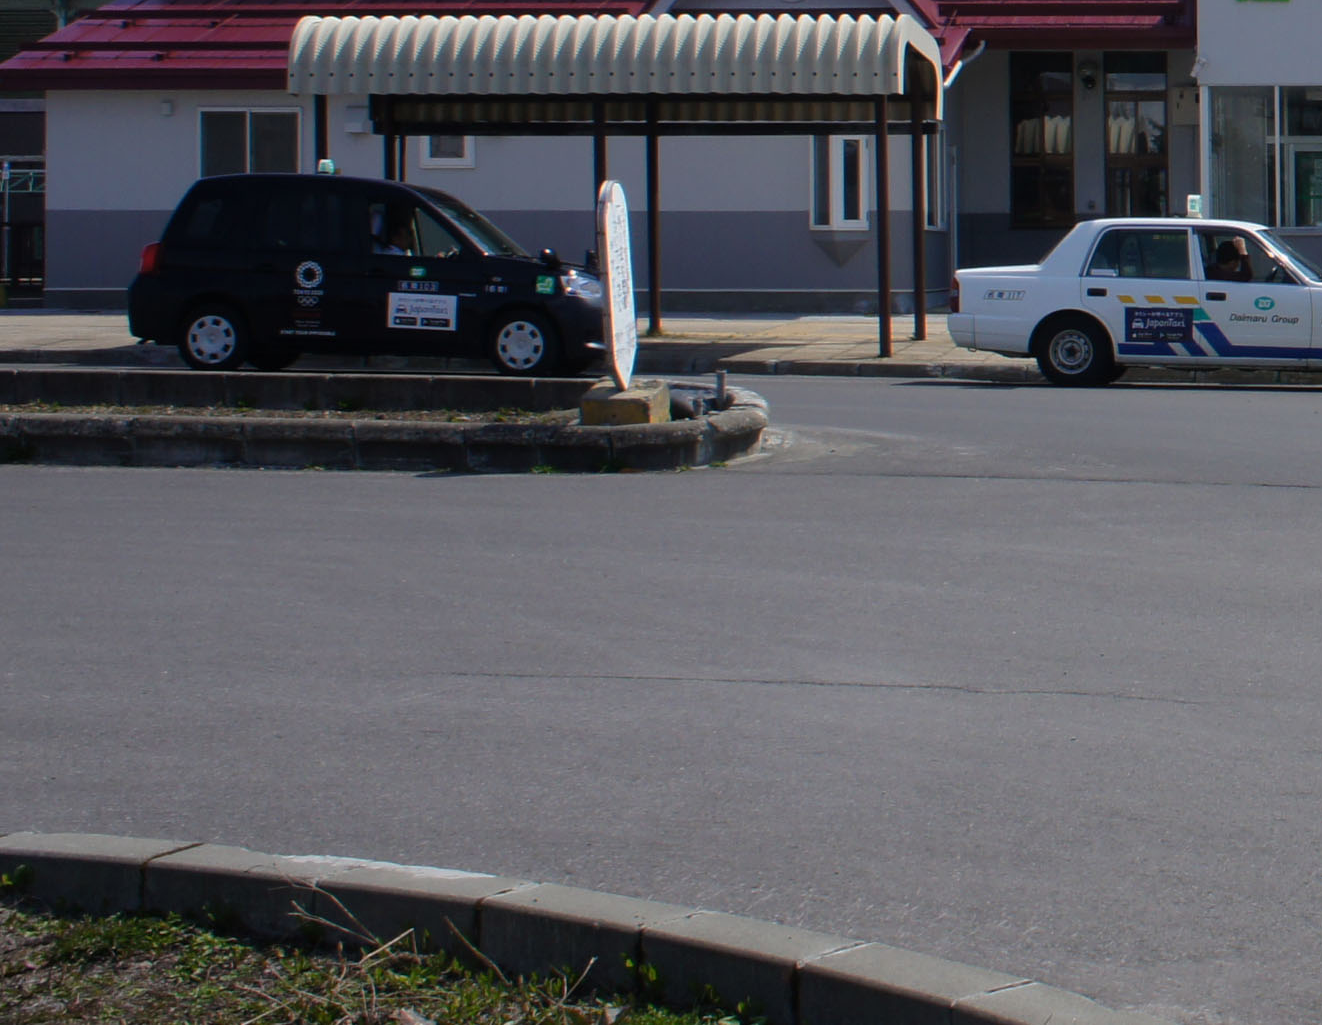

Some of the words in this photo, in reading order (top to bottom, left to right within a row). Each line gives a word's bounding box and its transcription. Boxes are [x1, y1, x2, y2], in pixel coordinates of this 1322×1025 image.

[1145, 318, 1186, 330] JapanTaxi
[1229, 312, 1268, 324] Daimaru
[1271, 314, 1299, 325] Group
